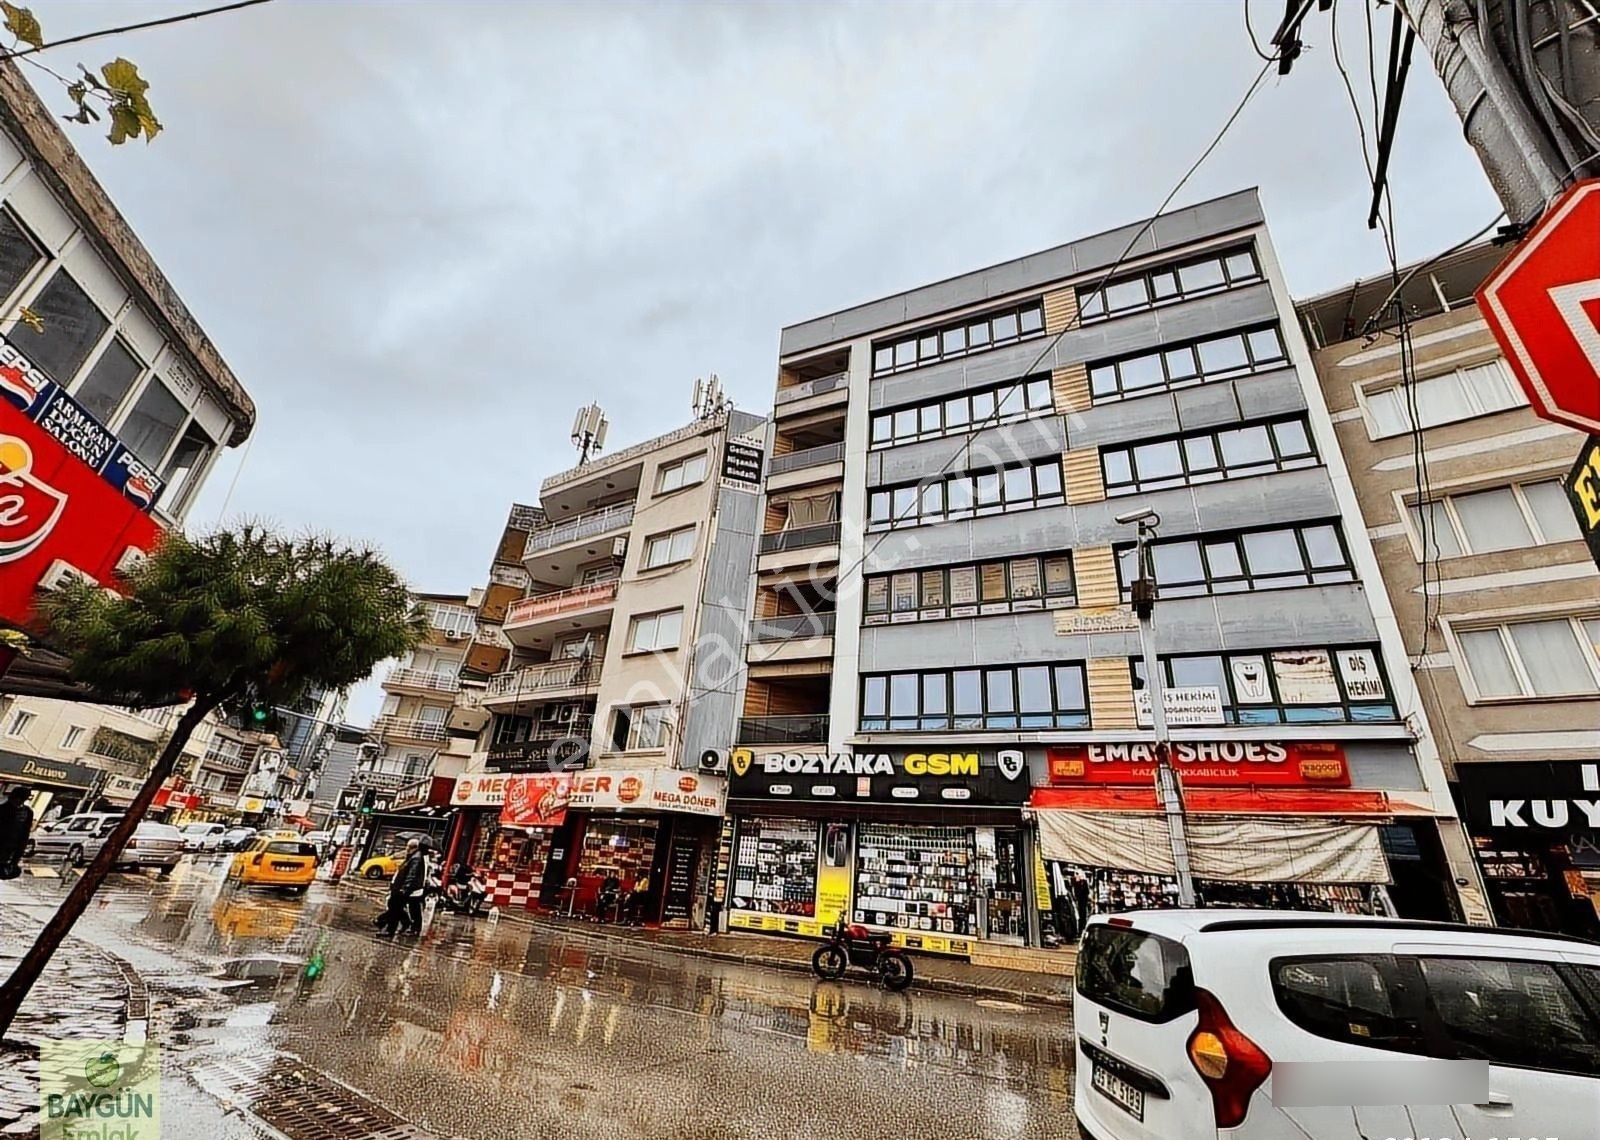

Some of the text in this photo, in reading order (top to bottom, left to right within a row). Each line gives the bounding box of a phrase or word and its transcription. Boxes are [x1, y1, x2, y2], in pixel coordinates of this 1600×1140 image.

[0, 336, 50, 393] EPSI
[41, 417, 100, 468] SALONU
[117, 452, 160, 493] PEPSI
[764, 753, 979, 776] BOZYAKA GSM
[1176, 743, 1288, 763] SHOES
[653, 791, 682, 803] MEGA
[683, 794, 717, 808] DÖNER
